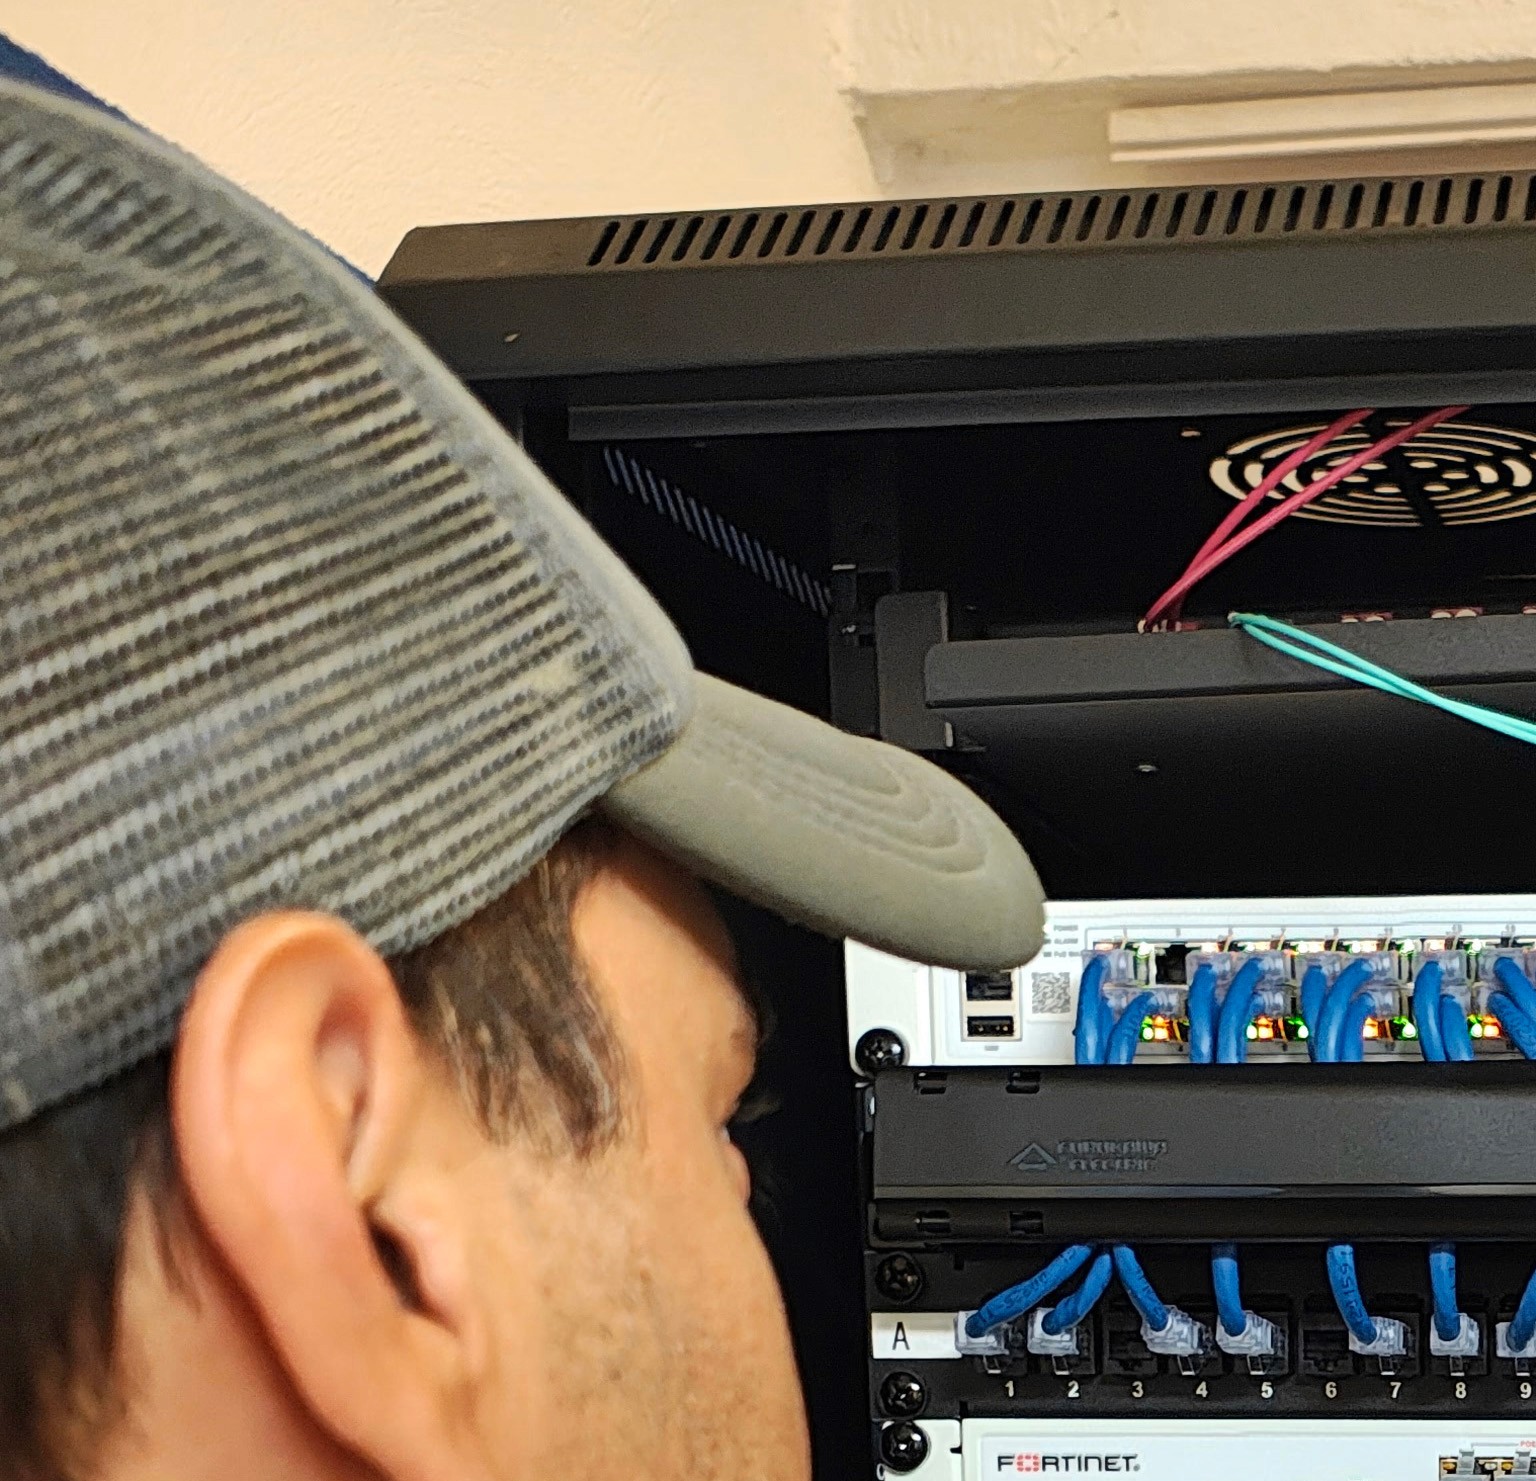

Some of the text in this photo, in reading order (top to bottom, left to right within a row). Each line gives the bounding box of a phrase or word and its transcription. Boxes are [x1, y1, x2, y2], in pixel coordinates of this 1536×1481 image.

[892, 1321, 910, 1350] A
[1005, 1380, 1014, 1397] 1
[1067, 1380, 1080, 1398] 2
[1132, 1381, 1144, 1398] 3
[1195, 1381, 1208, 1398] 4
[1261, 1381, 1274, 1399] 5
[1325, 1381, 1337, 1399] 6
[1390, 1381, 1402, 1399] 7
[1455, 1381, 1467, 1399] 8
[1519, 1382, 1532, 1399] 9
